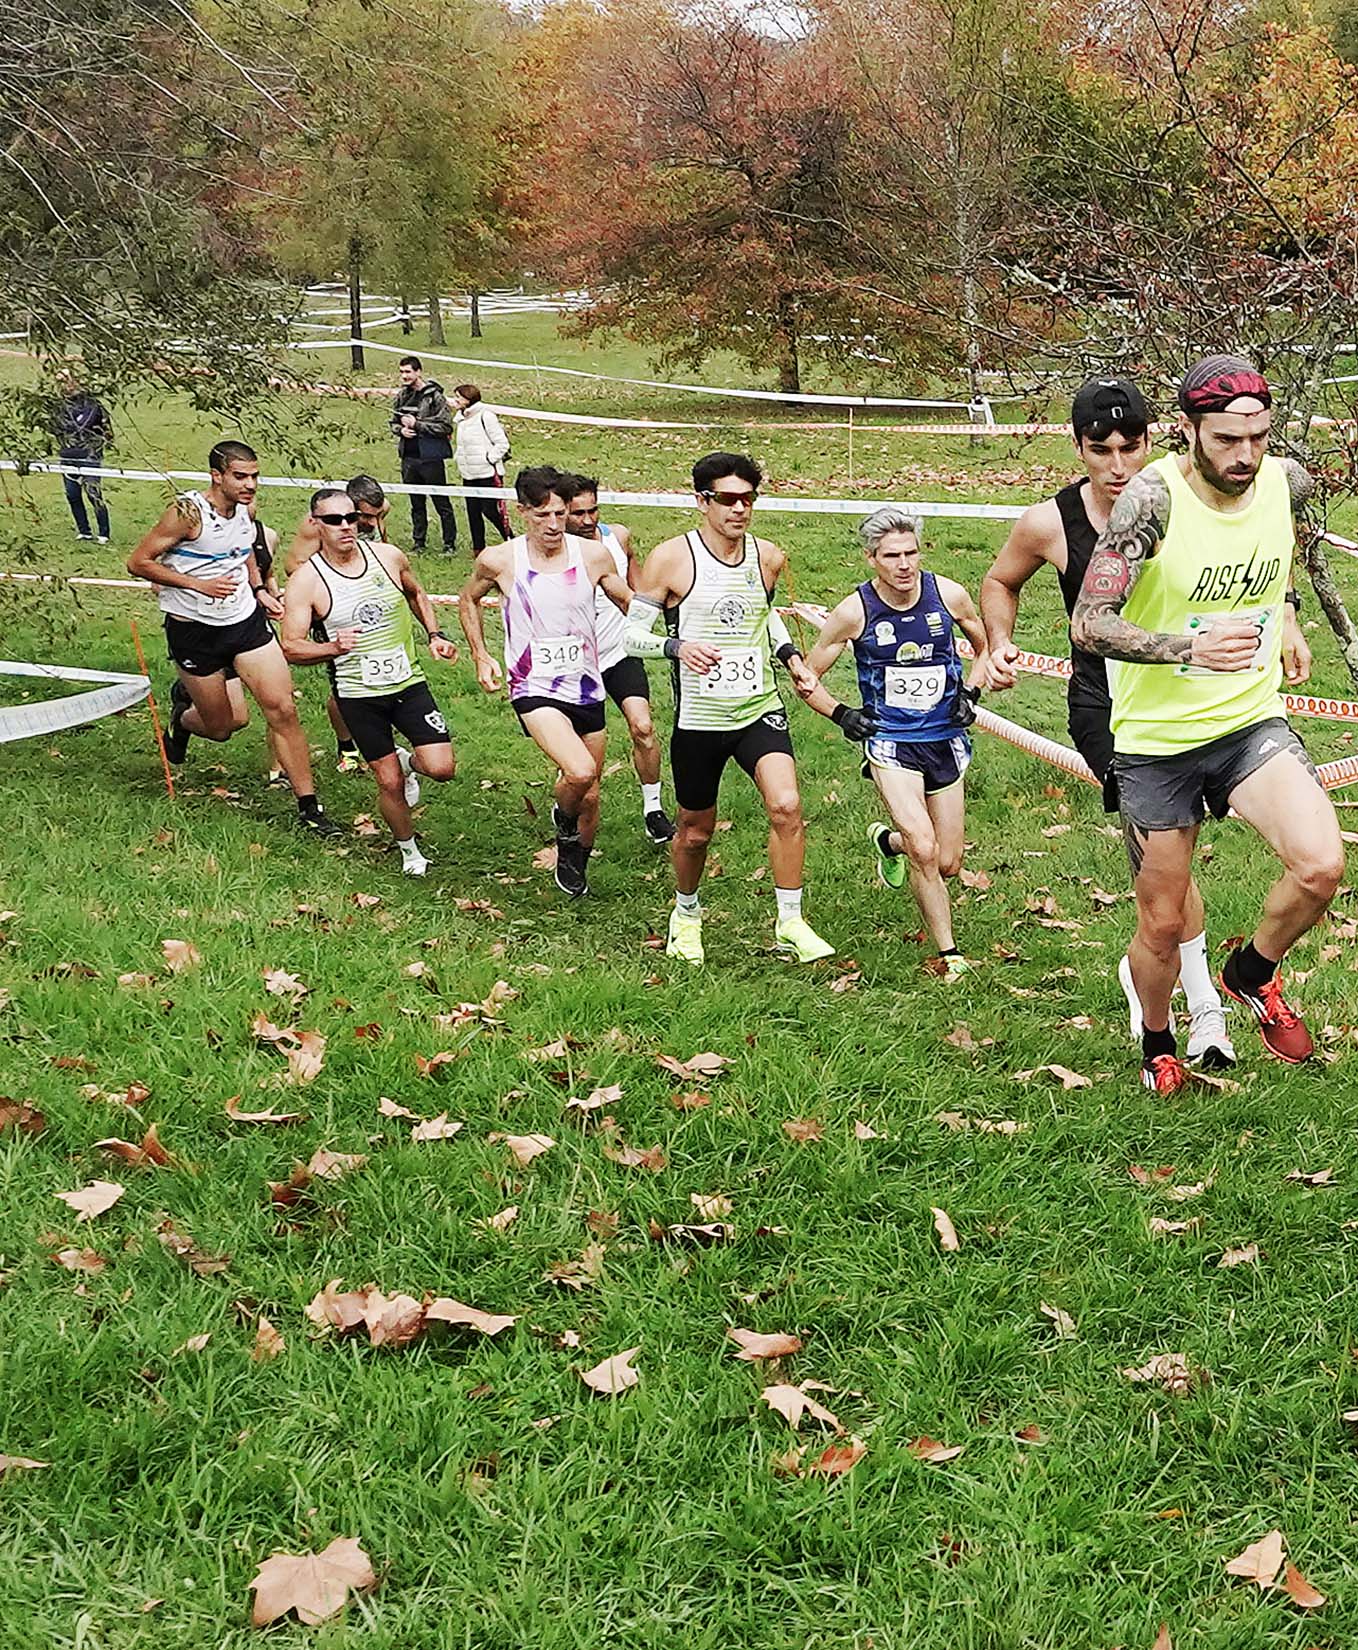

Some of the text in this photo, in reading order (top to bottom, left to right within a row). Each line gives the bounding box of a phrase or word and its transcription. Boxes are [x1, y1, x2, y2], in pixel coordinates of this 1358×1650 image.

[1188, 557, 1281, 602] RISE UP
[708, 661, 756, 682] 338
[893, 677, 939, 697] 329
